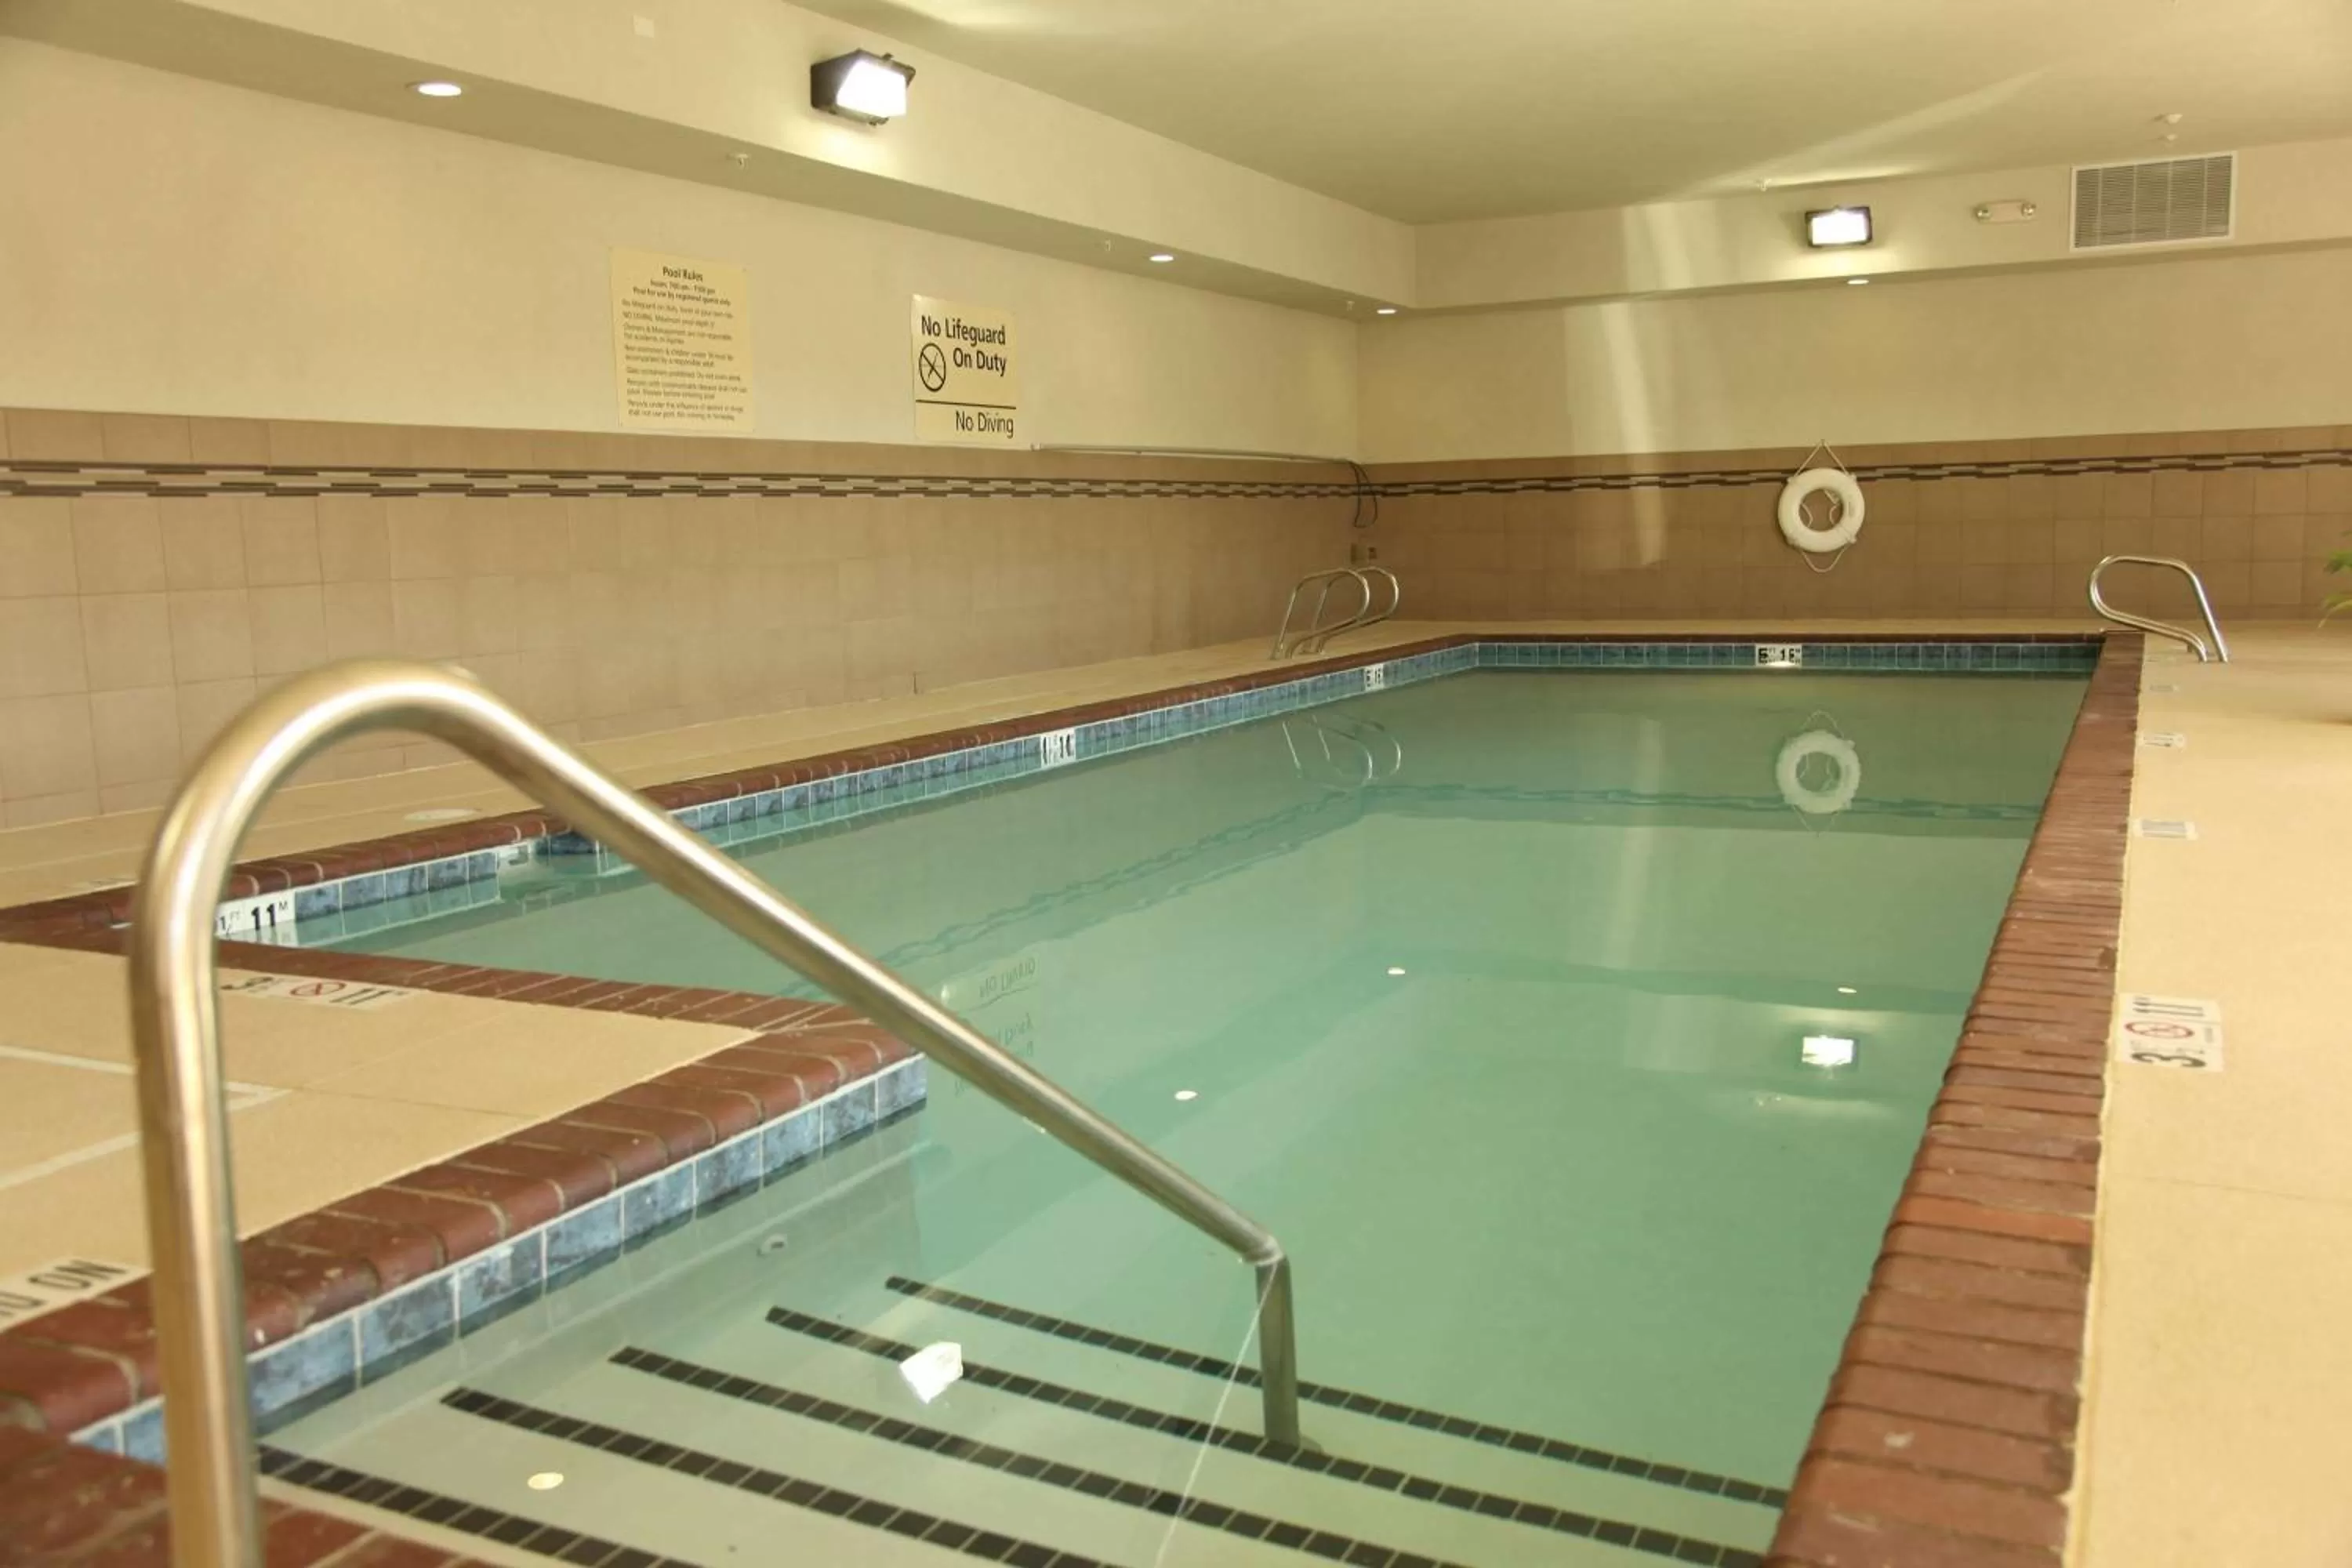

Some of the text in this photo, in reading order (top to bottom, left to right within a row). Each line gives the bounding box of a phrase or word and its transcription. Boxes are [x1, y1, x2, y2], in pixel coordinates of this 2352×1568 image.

[662, 266, 681, 278] Pool
[921, 314, 1006, 347] No Lifeguard
[953, 347, 1007, 377] On Duty
[956, 411, 1014, 439] No Diving
